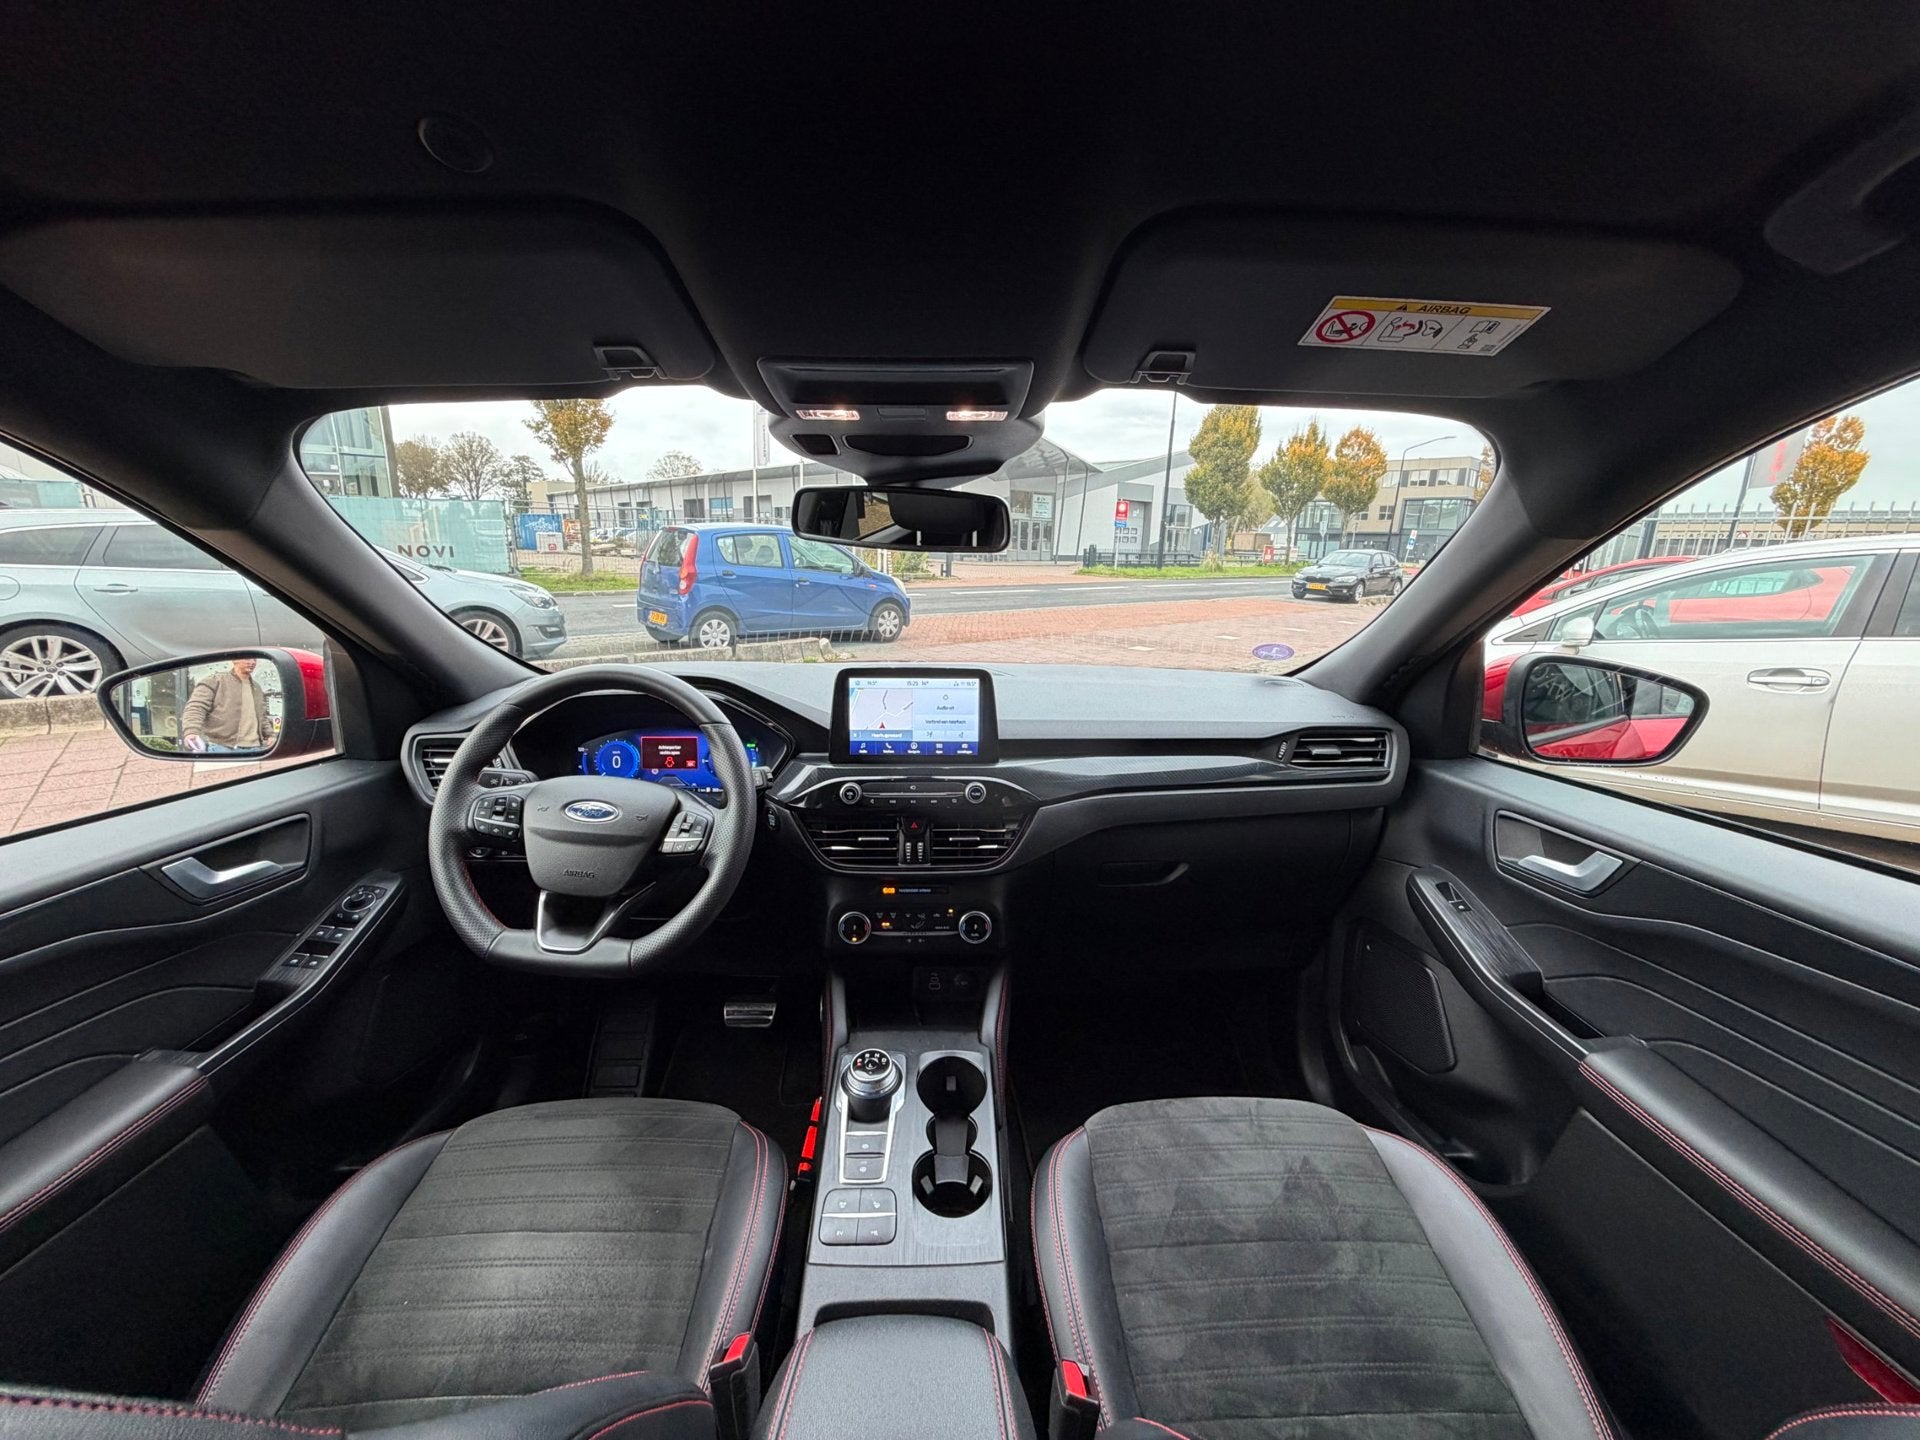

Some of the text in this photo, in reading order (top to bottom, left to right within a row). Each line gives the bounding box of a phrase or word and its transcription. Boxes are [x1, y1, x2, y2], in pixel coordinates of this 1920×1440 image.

[1416, 304, 1472, 315] AIRBAG
[397, 544, 455, 558] NOVI
[612, 755, 621, 769] 0
[563, 869, 595, 879] AIRBAG
